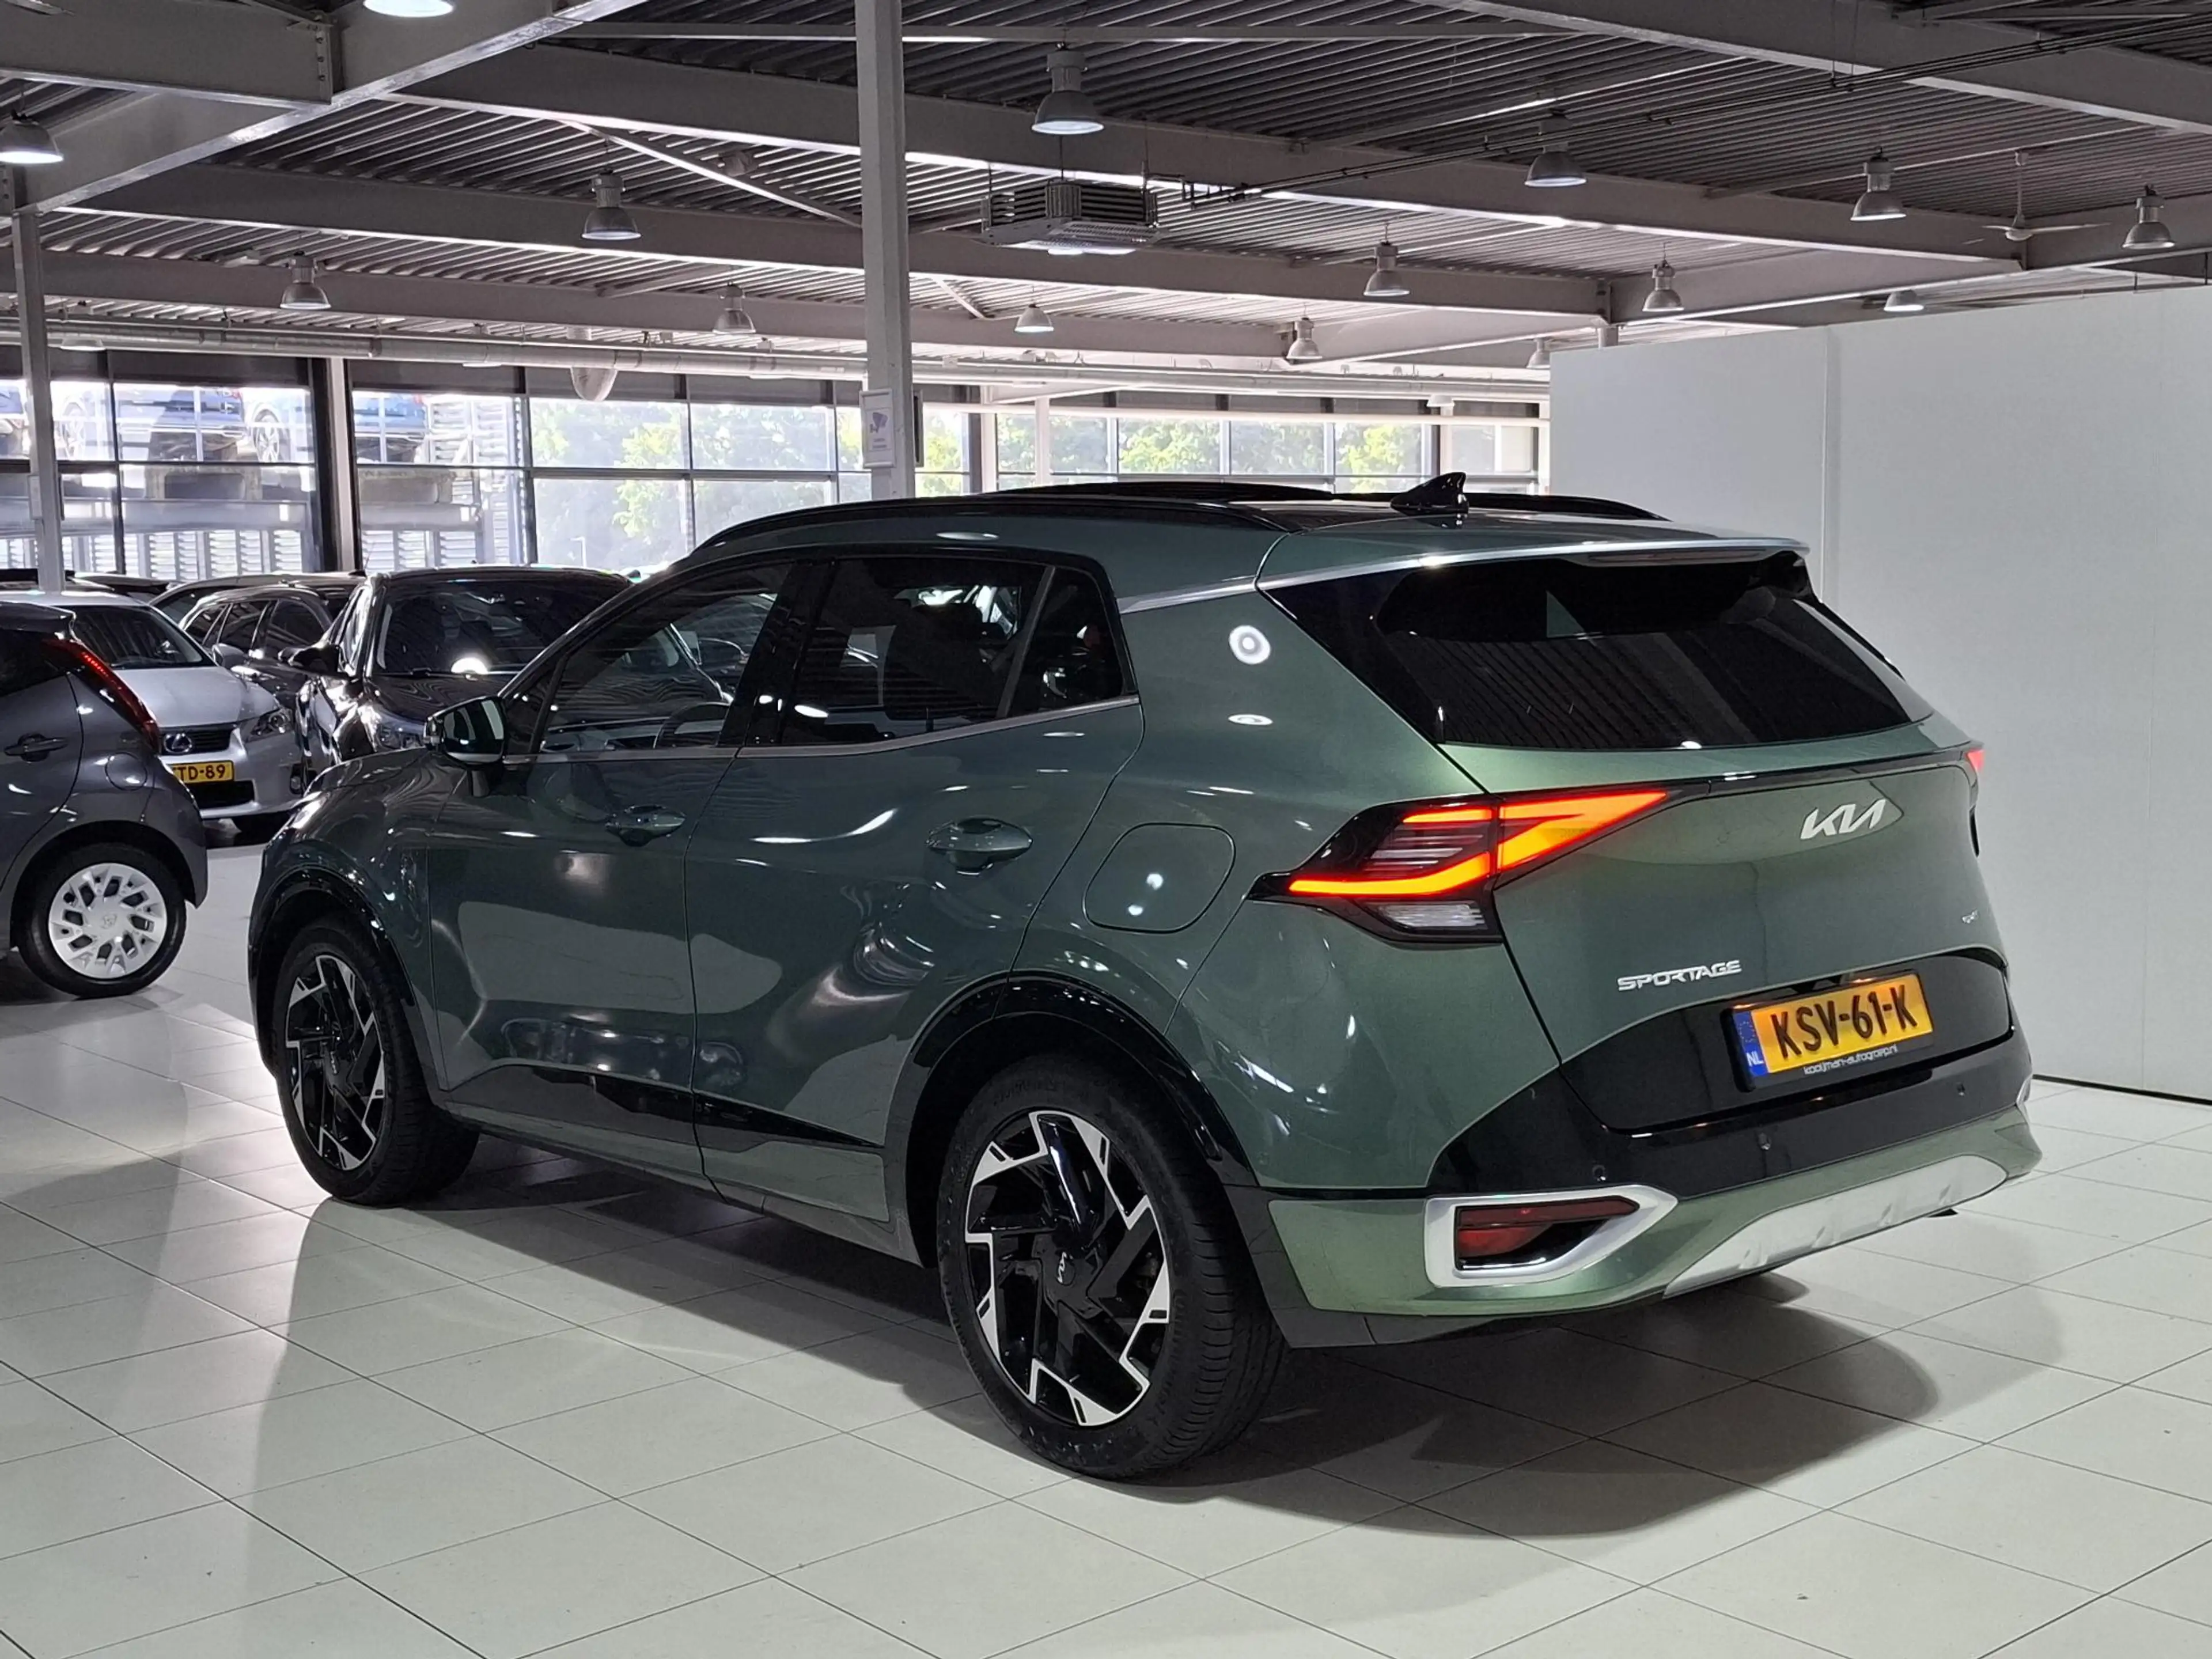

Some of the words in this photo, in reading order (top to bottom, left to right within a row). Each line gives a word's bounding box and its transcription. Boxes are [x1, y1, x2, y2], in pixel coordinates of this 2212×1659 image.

[1800, 798, 1887, 839] KIA
[1617, 960, 1742, 991] SPORTAGE
[1770, 984, 1918, 1059] KSV-61-K
[1746, 1051, 1763, 1066] NL
